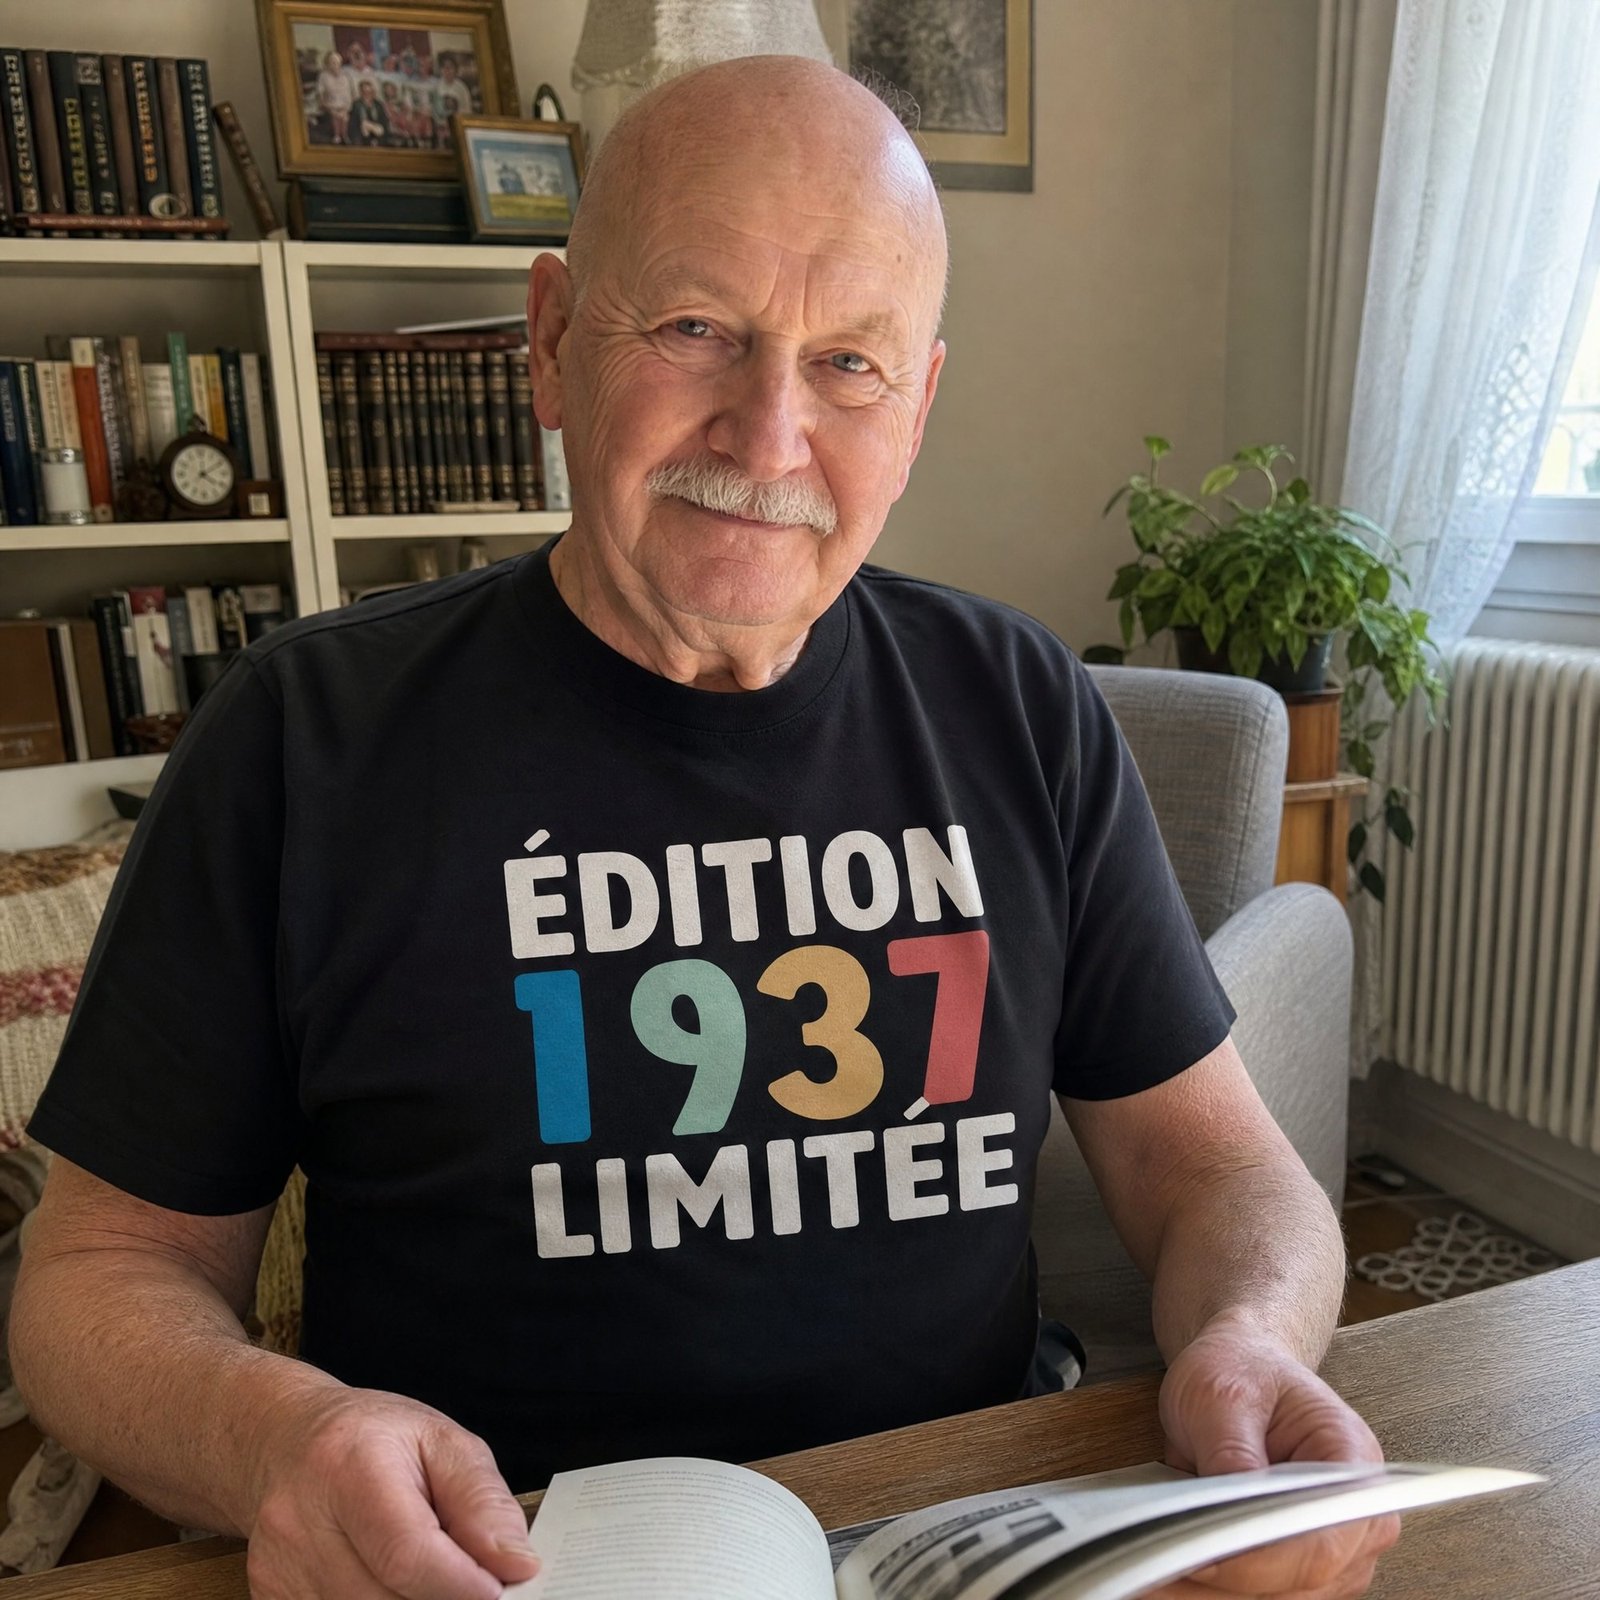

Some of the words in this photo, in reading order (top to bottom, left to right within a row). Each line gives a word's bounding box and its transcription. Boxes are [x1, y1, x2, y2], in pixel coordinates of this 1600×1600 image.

[504, 825, 985, 959] ÉDITION
[514, 930, 990, 1144] 1937
[531, 1096, 1019, 1259] LIMITÉE
